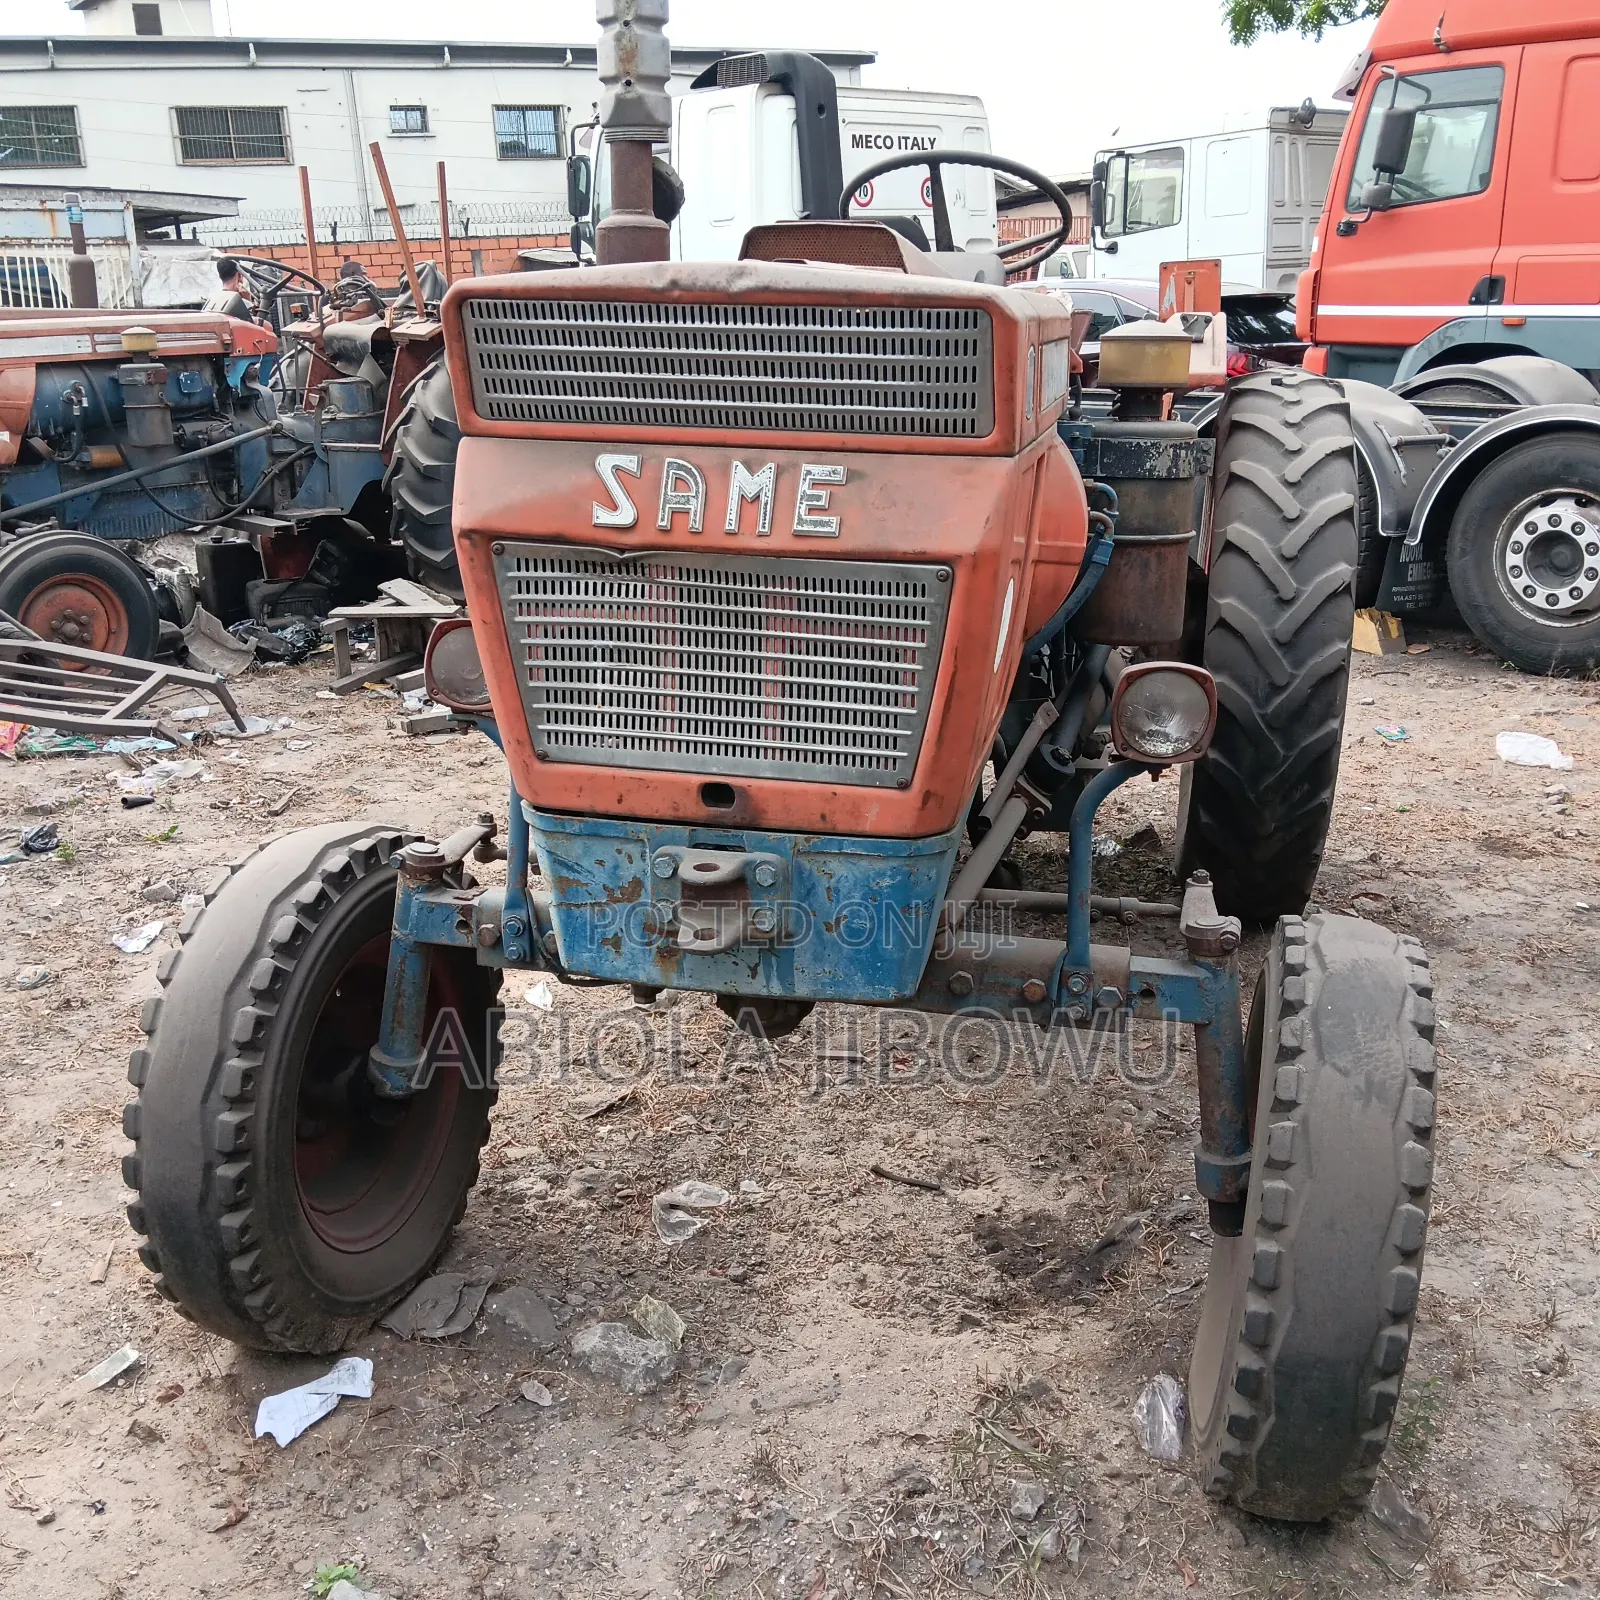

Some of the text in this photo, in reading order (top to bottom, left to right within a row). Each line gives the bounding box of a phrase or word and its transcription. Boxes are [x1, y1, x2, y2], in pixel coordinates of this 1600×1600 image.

[851, 133, 937, 151] MECO ITALY
[592, 453, 848, 537] SAME
